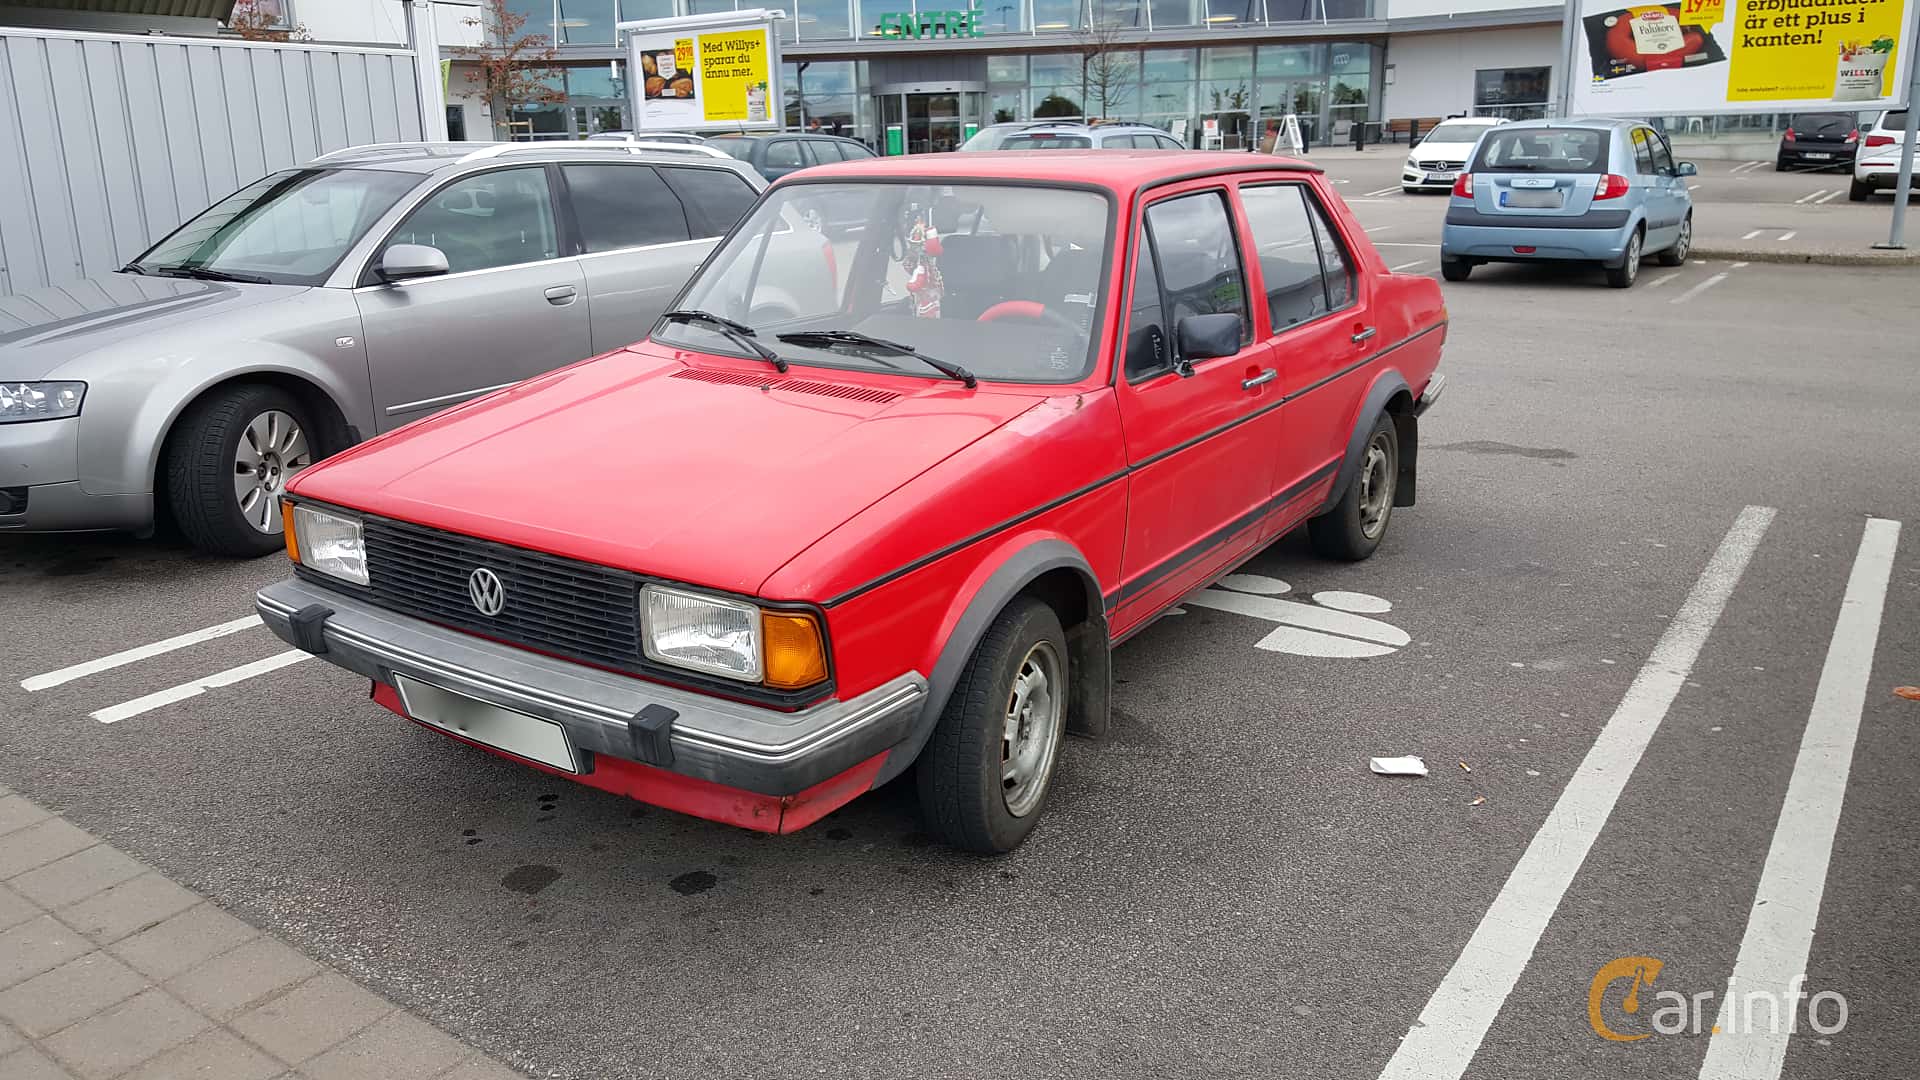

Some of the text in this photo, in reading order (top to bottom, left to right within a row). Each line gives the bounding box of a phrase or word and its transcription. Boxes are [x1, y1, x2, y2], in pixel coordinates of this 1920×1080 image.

[1744, 8, 1865, 29] är ett plus i
[703, 39, 761, 53] Med Willys+
[1742, 30, 1823, 48] kanten!
[704, 54, 751, 69] sparar du
[705, 66, 753, 79] ännu mer.
